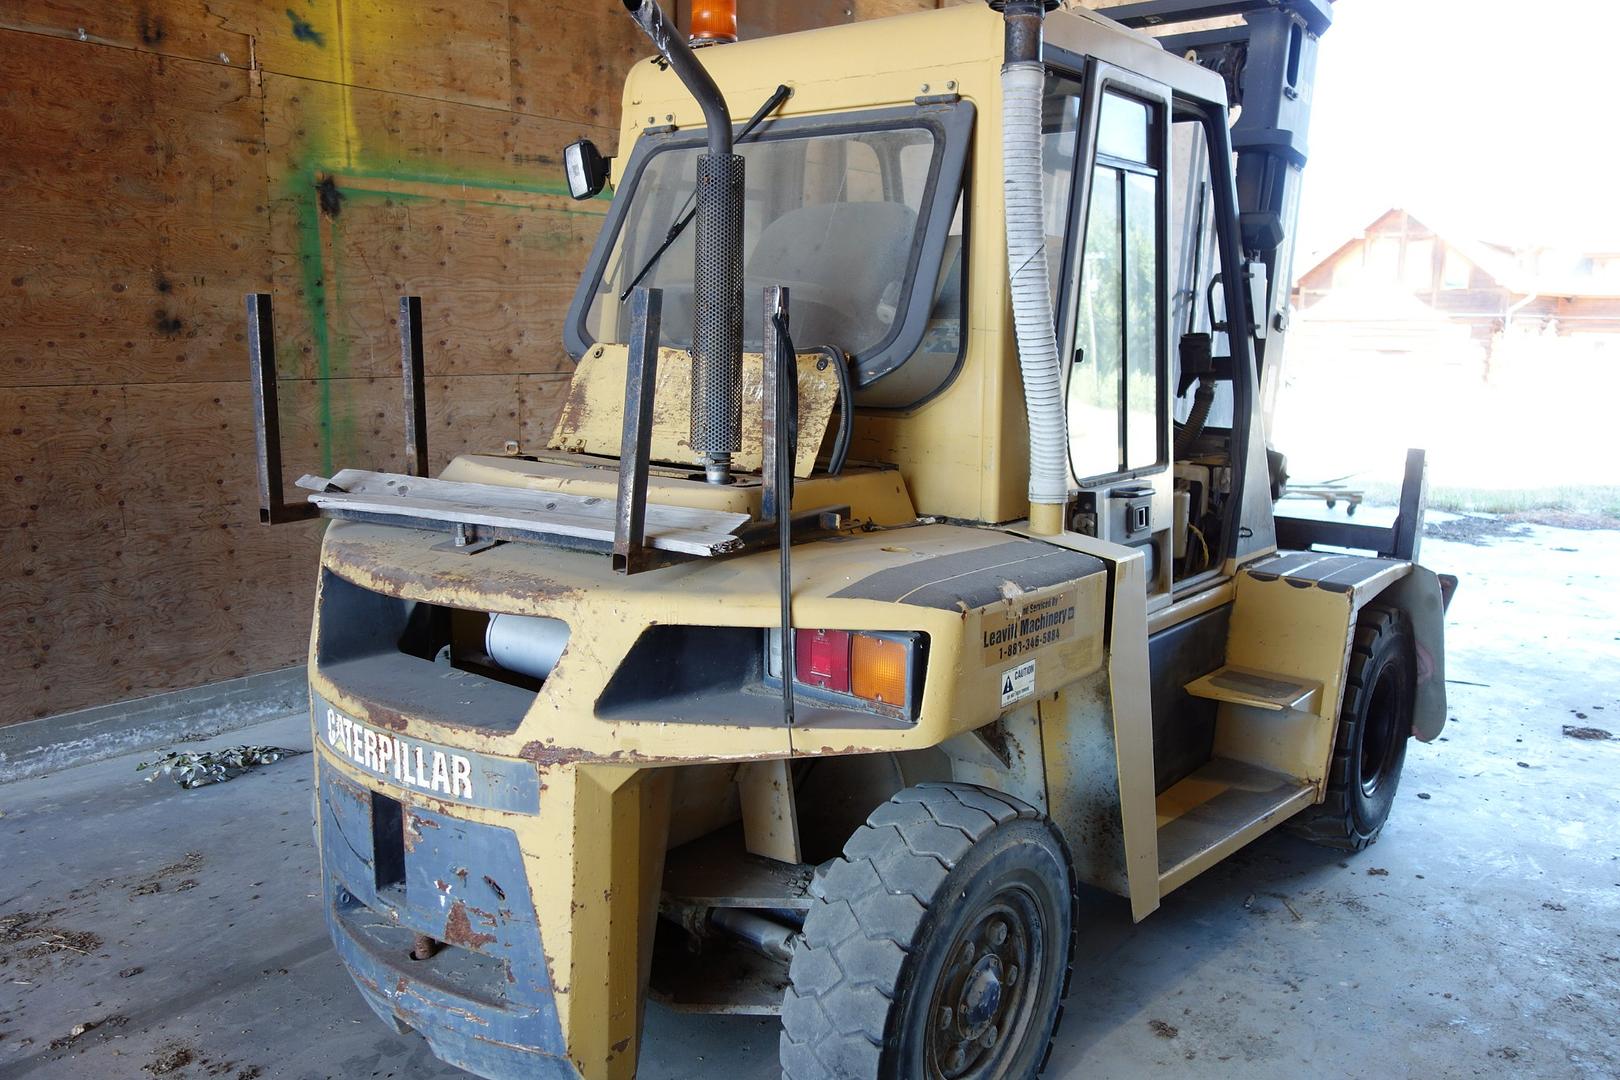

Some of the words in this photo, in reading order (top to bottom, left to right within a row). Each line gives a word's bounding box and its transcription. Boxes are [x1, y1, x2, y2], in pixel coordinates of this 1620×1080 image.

[1020, 609, 1067, 636] Machinery
[1014, 664, 1034, 680] CAUTION
[326, 708, 473, 799] CATERPILLAR
